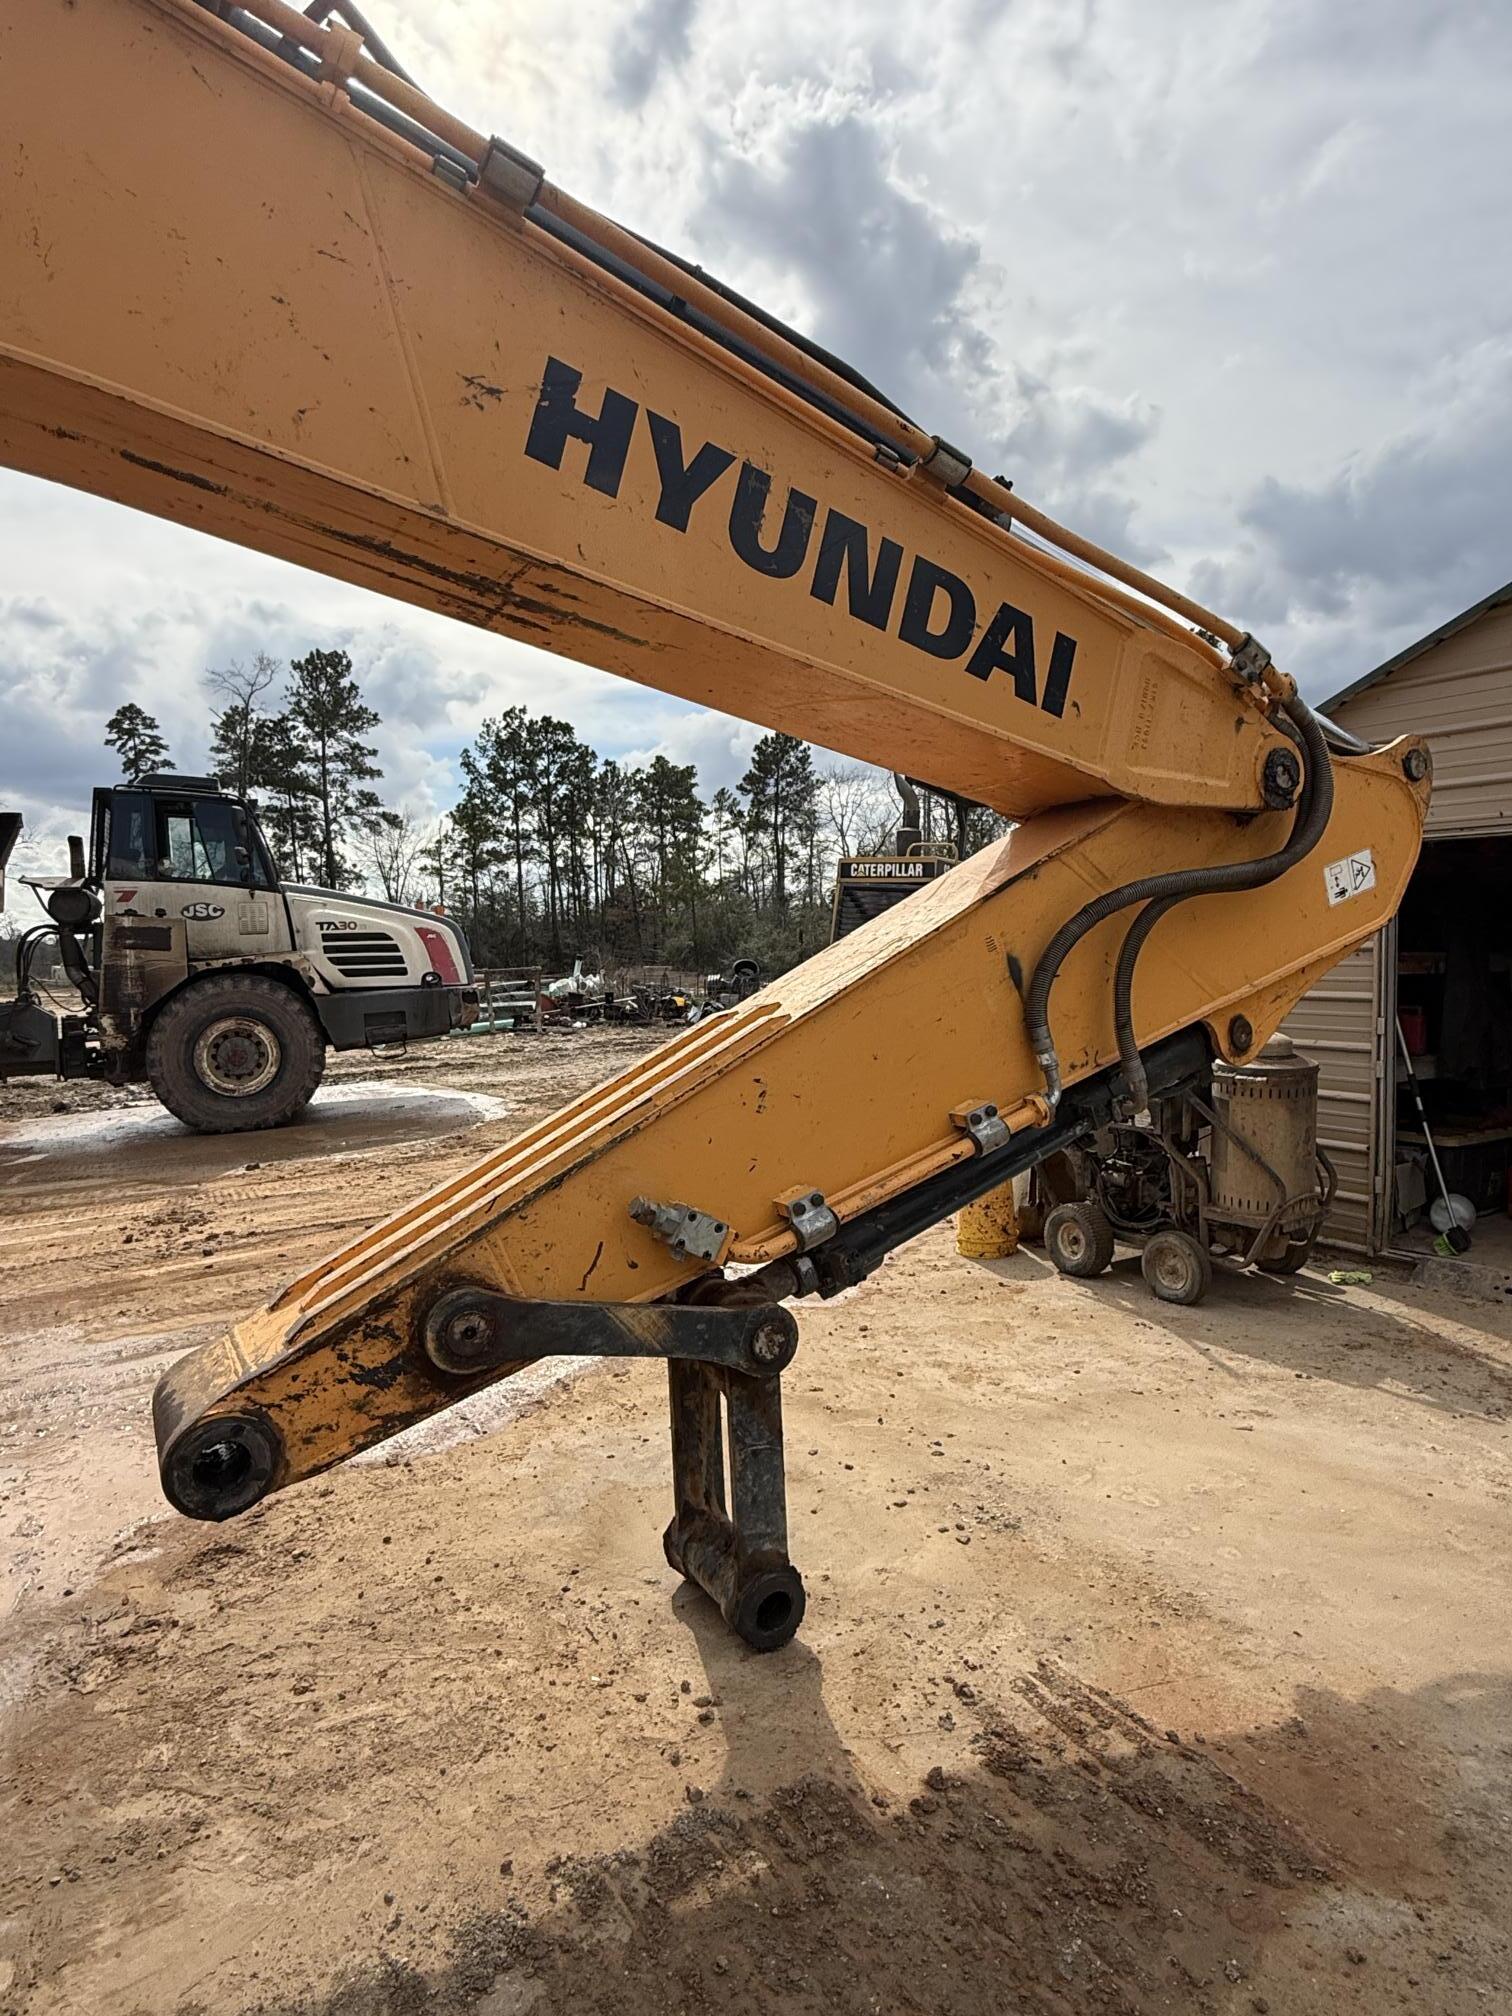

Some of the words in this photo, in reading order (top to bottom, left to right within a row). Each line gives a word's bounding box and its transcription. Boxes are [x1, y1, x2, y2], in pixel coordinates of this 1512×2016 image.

[524, 356, 1077, 718] HYUNDAI
[850, 863, 923, 877] CATERPILLAR
[183, 903, 222, 917] JSC
[315, 921, 358, 931] TA30
